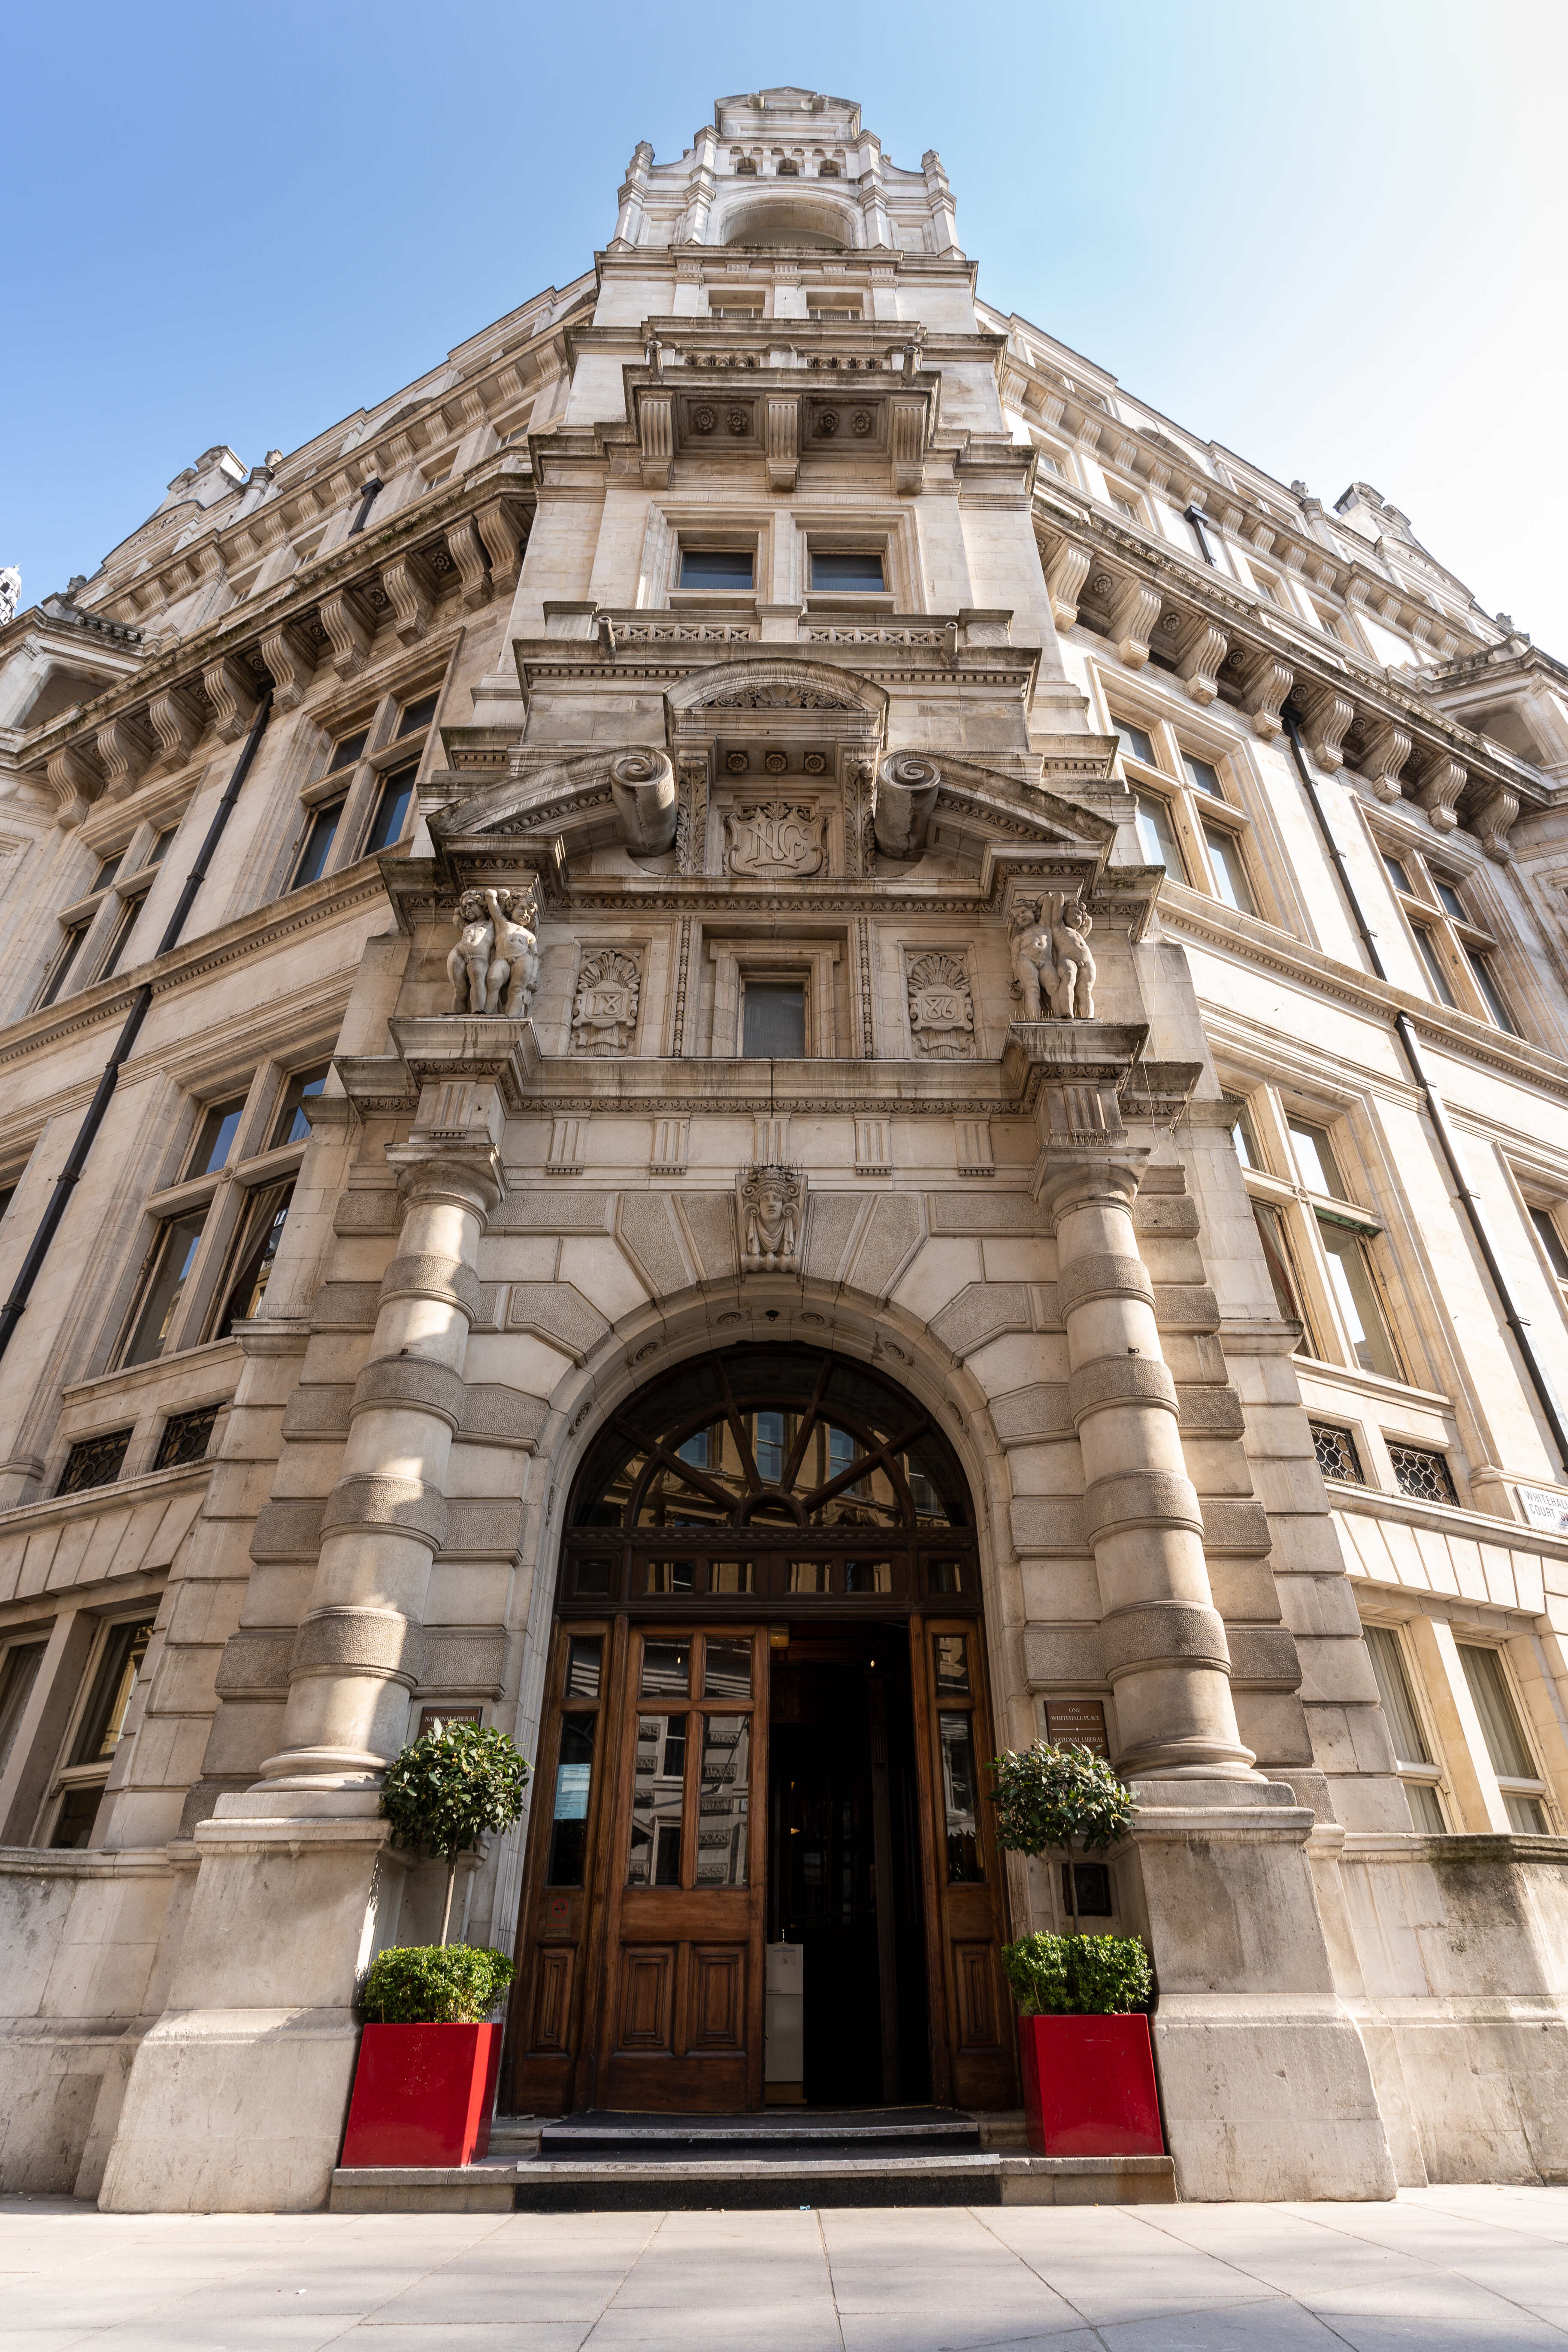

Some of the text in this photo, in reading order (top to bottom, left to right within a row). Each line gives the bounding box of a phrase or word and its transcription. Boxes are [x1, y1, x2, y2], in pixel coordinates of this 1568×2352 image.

[592, 994, 621, 1015] 18
[925, 998, 956, 1019] 86
[1529, 1503, 1555, 1519] COURT
